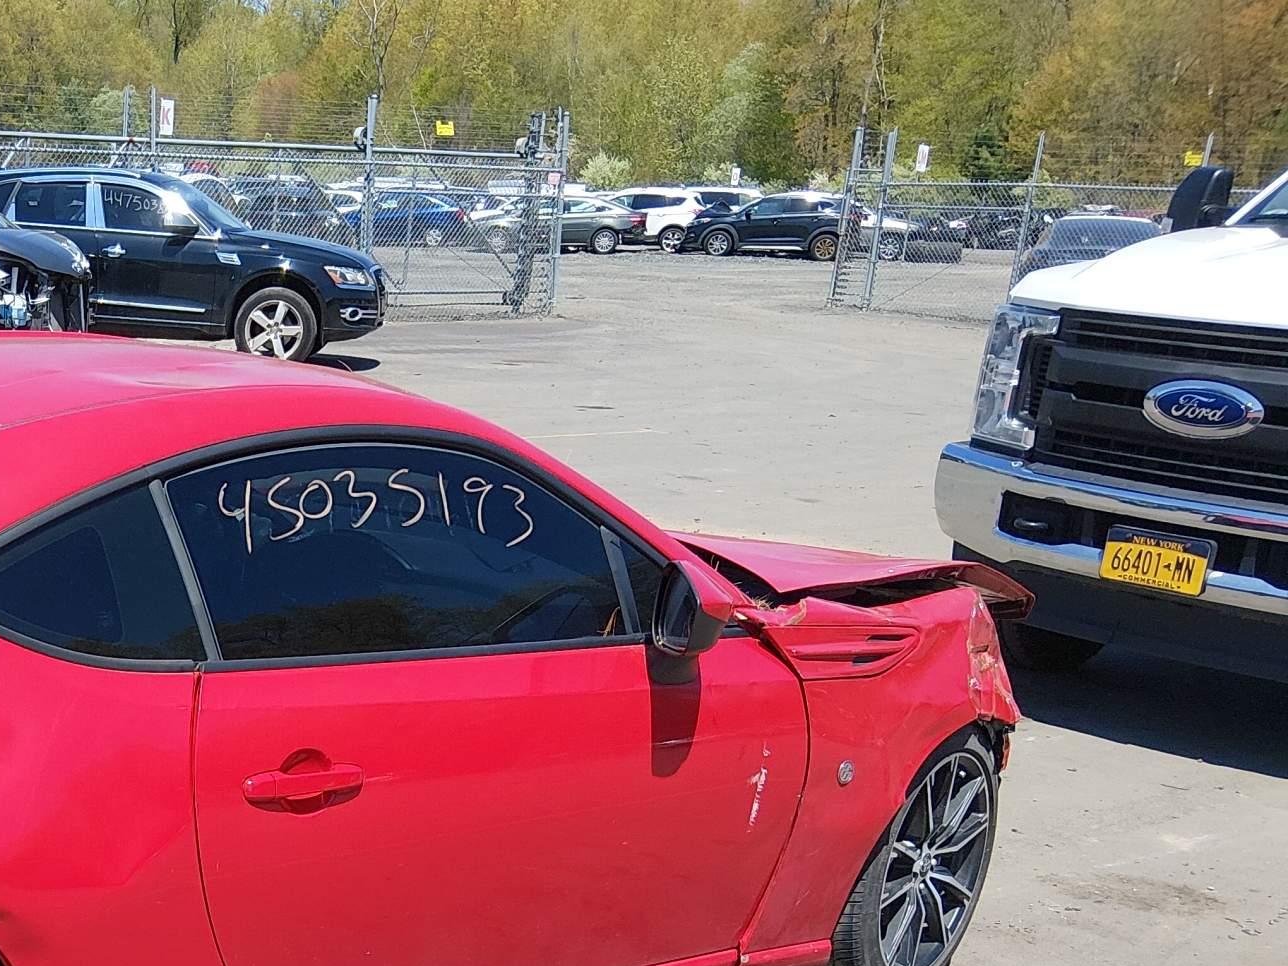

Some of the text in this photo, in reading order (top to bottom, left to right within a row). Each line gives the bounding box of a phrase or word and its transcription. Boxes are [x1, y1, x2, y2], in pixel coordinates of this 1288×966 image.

[1170, 393, 1229, 422] Ford
[218, 468, 534, 554] 45035193
[1132, 535, 1186, 552] NEW YORK
[1111, 546, 1196, 585] 66401 MN
[1122, 573, 1176, 590] COMMERCIAL
